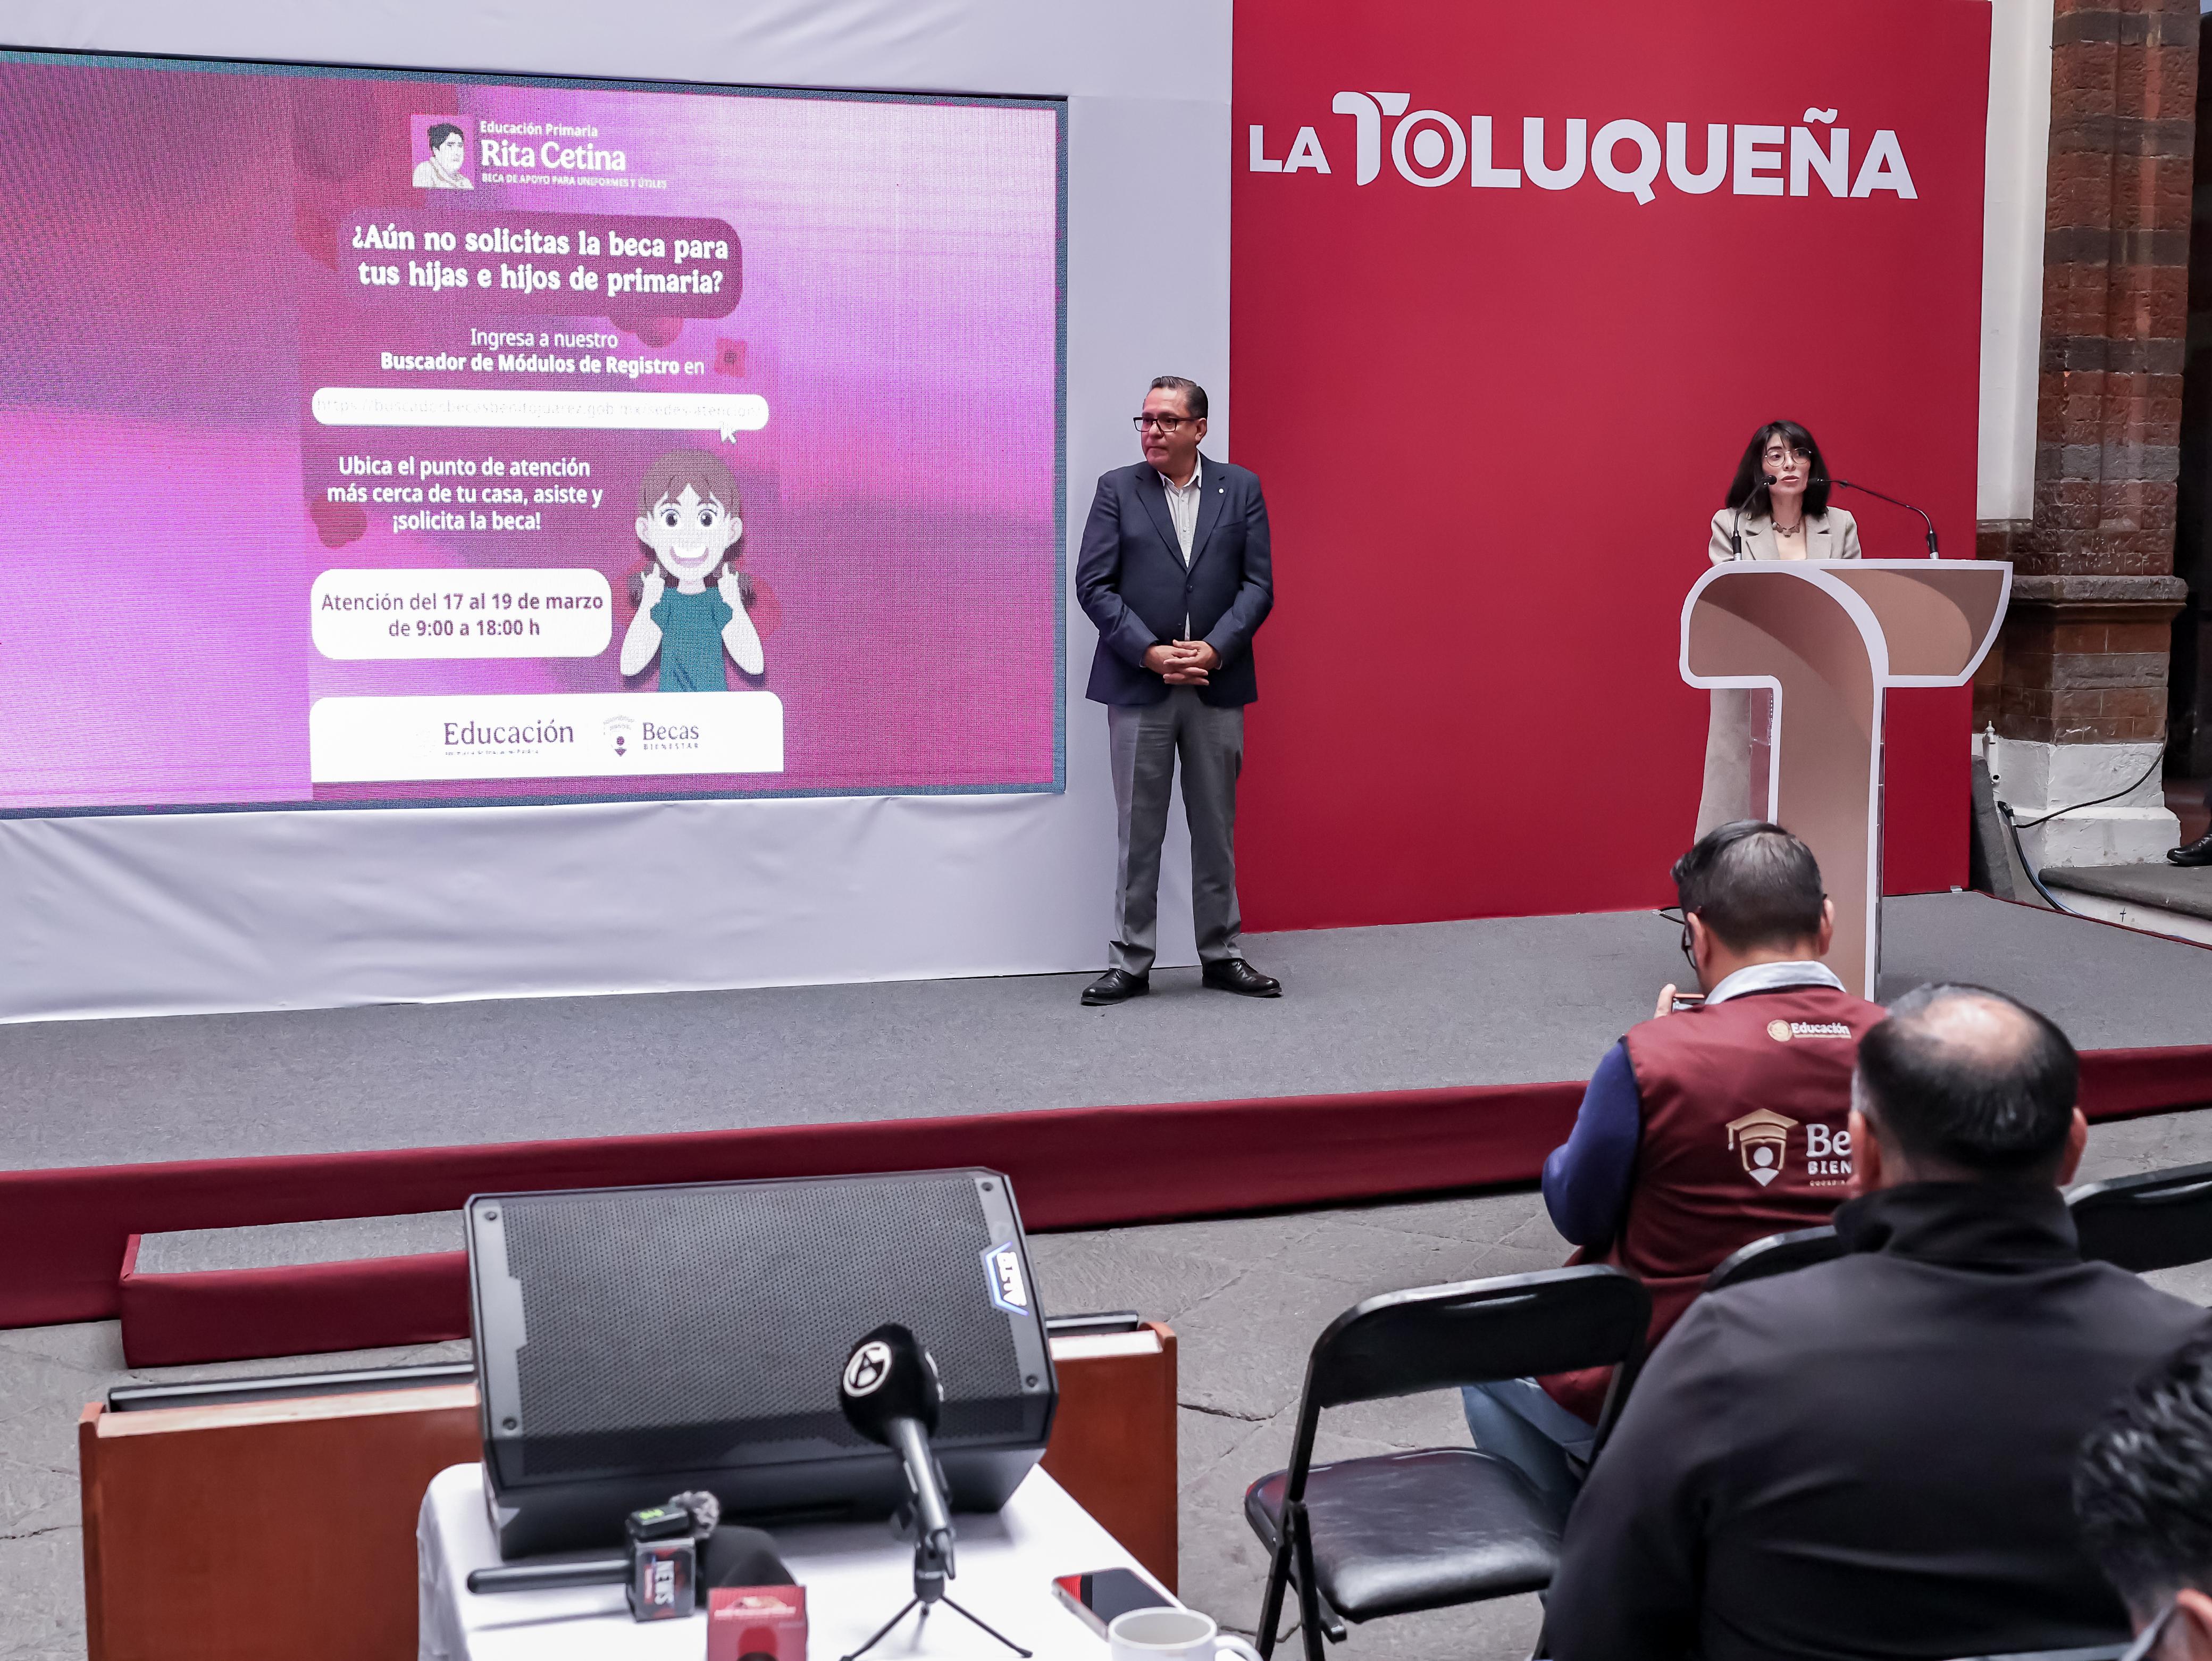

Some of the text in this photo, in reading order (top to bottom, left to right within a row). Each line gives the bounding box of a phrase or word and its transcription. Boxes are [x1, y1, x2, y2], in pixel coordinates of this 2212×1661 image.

[480, 120, 599, 138] Educación Primaria
[481, 139, 626, 172] Rita Cetina
[1249, 91, 1918, 206] LA TOLUQUEÑA
[481, 172, 668, 190] BECA DE APOYO PARA UNIFORMES Y ÚTILES
[352, 223, 728, 264] ¿Aún no solicitas la beca para
[358, 260, 723, 297] tus hijas e hijos de primaria?
[471, 328, 619, 351] Ingresa a nuestro
[381, 352, 705, 379] Buscador de Módulos de Registro en
[339, 455, 590, 481] Ubica el punto de atención
[327, 482, 603, 508] más cerca de tu casa, asiste y
[393, 510, 541, 533] ¡solicita la beca!
[321, 592, 604, 612] Atención del 17 al 19 de marzo
[388, 619, 540, 637] de 9:00 a 18:00 h
[443, 719, 574, 746] Educación
[642, 722, 699, 741] Becas
[1790, 1022, 1850, 1035] Educación
